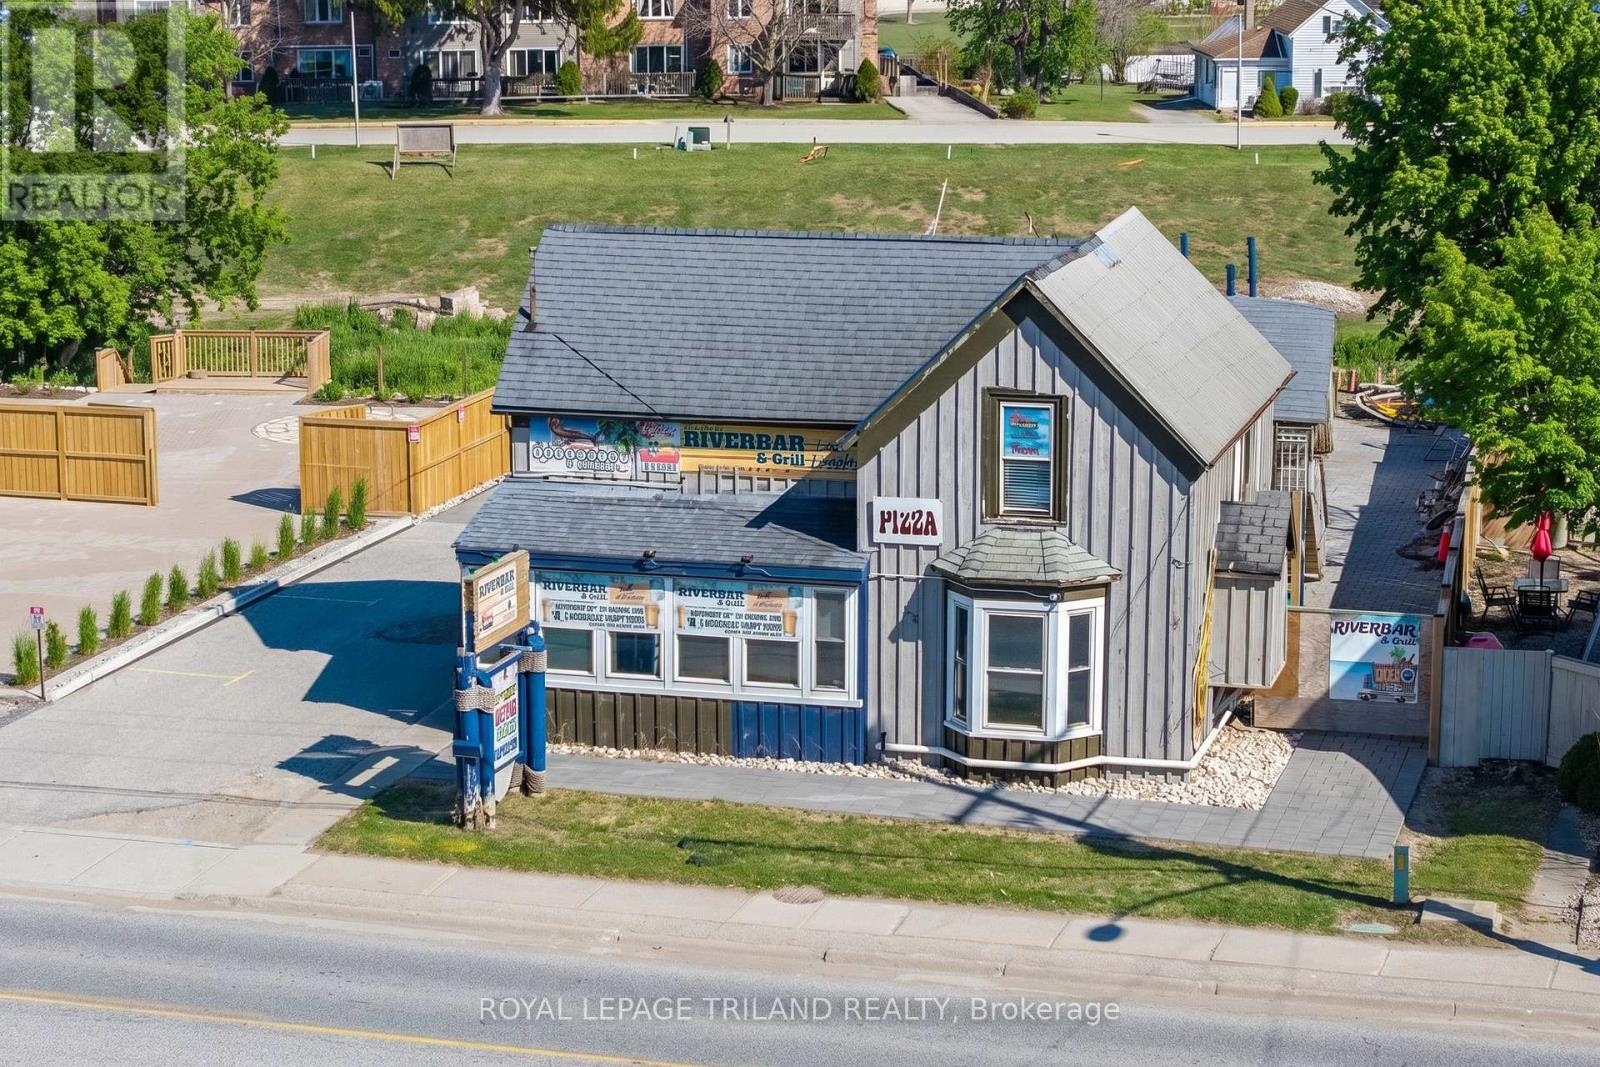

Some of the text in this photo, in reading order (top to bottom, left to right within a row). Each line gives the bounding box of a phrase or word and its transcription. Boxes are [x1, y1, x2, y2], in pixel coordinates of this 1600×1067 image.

[684, 431, 805, 451] RIVERBAR
[756, 453, 768, 464] &
[772, 453, 805, 466] Grill
[879, 509, 938, 536] PIZZA
[479, 569, 515, 598] RIVERBAR
[542, 581, 608, 593] RIVERBAR
[678, 587, 745, 600] RIVERBAR
[1334, 621, 1416, 638] RIVERBAR
[1380, 637, 1390, 645] &
